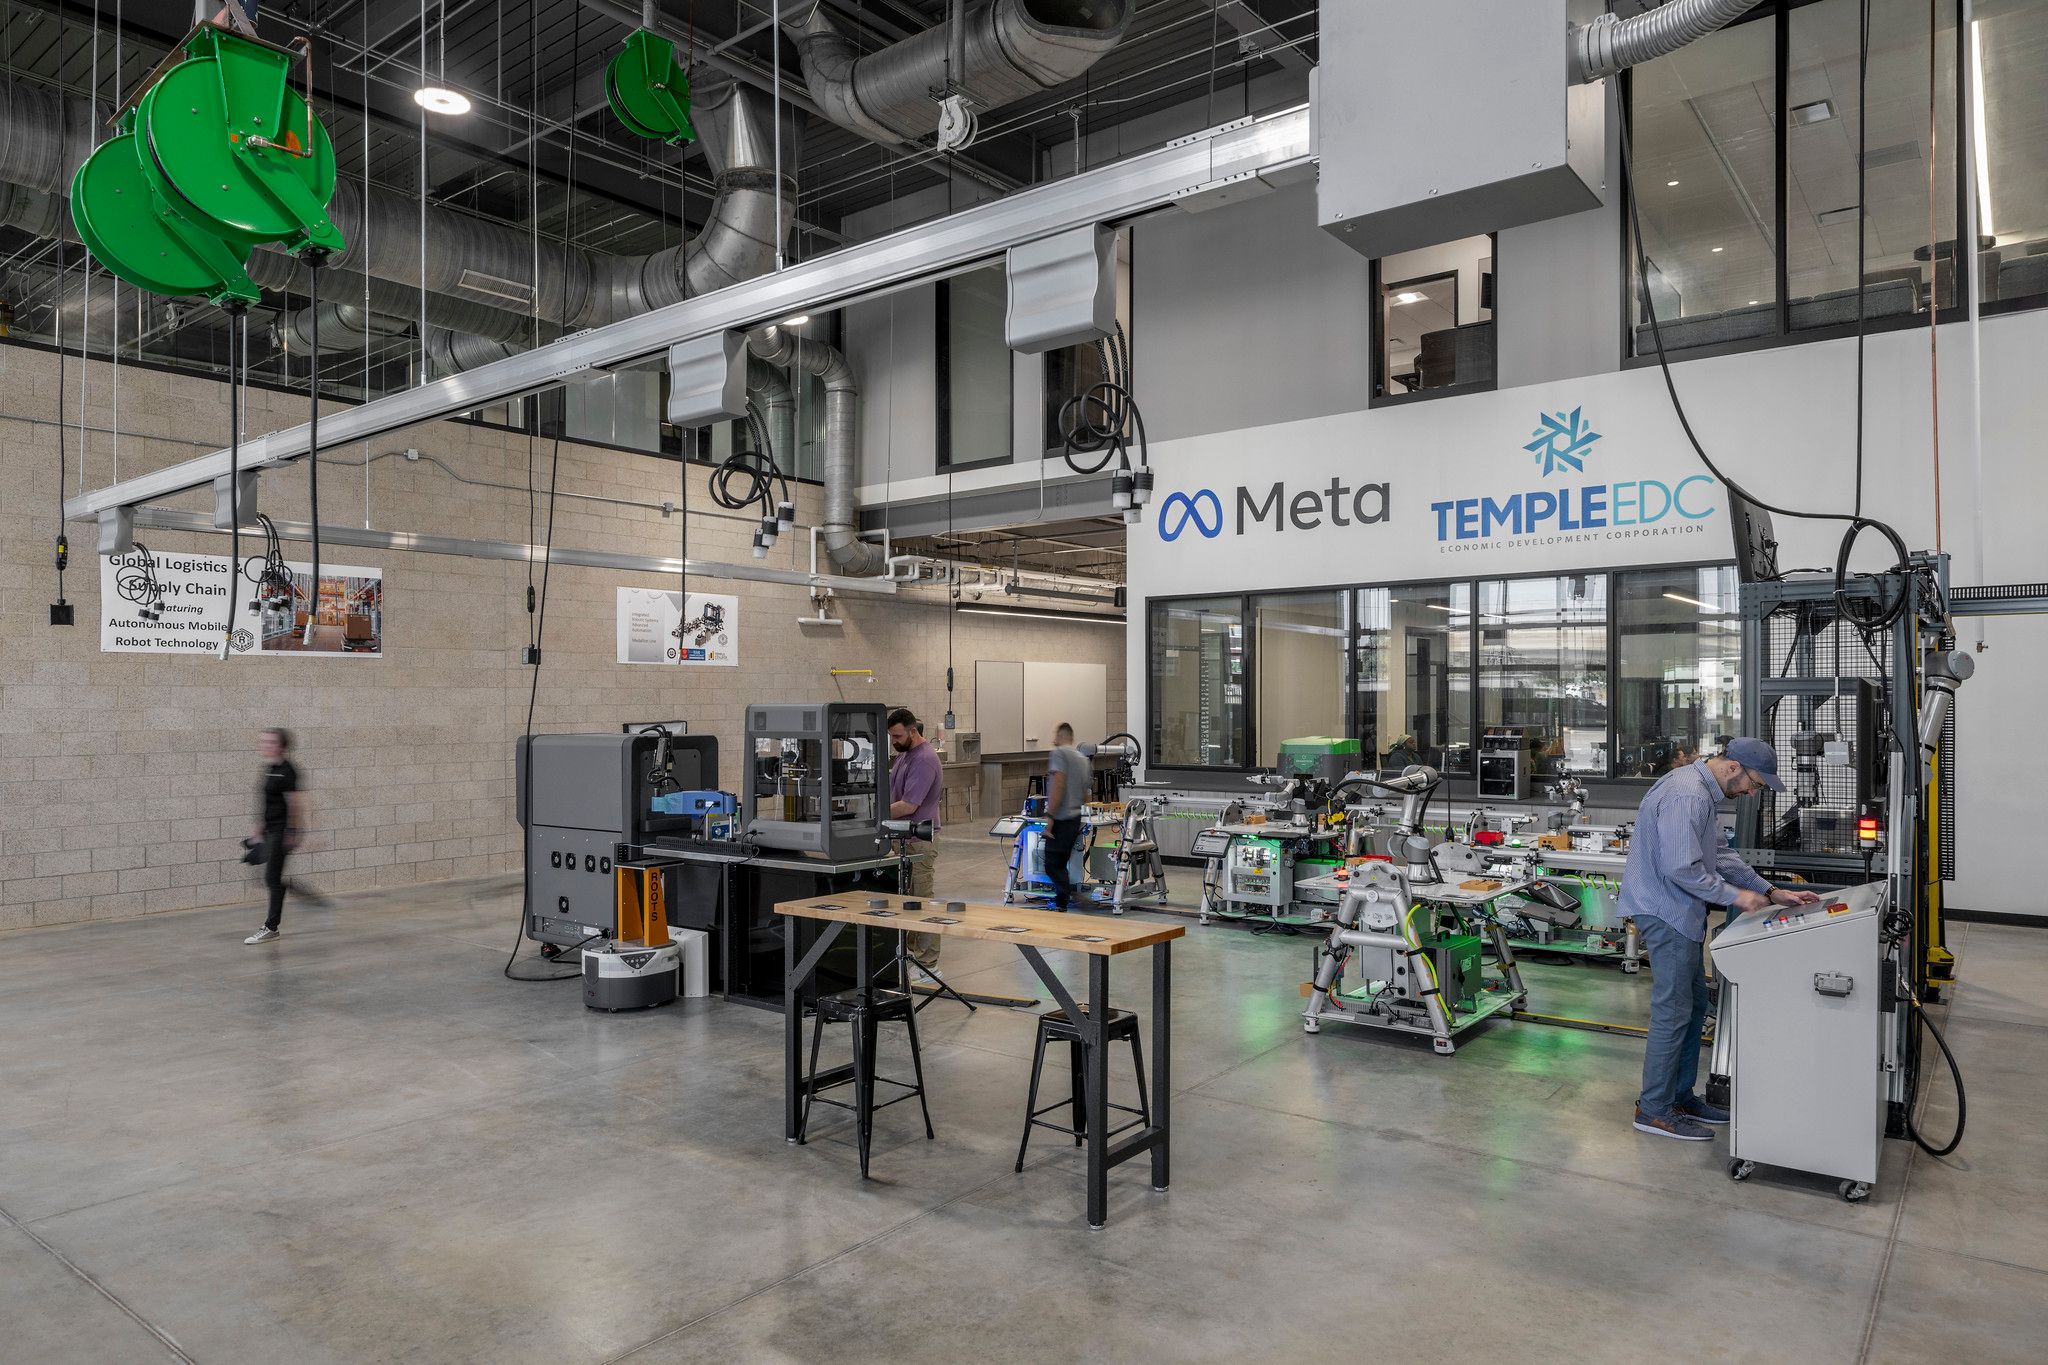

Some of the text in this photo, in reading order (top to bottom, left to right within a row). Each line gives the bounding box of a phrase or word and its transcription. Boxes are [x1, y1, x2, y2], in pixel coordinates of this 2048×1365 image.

[1236, 477, 1390, 536] Meta
[1431, 484, 1607, 542] TEMPLE
[1440, 524, 1704, 554] ECONOMIC DEVELOPMENT CORPORATION
[109, 553, 160, 568] Global
[165, 557, 228, 573] Logistics
[185, 582, 227, 596] Chain
[161, 604, 204, 615] aturing
[108, 618, 228, 632] Autonomous Mobile
[115, 636, 219, 651] Robot Technology
